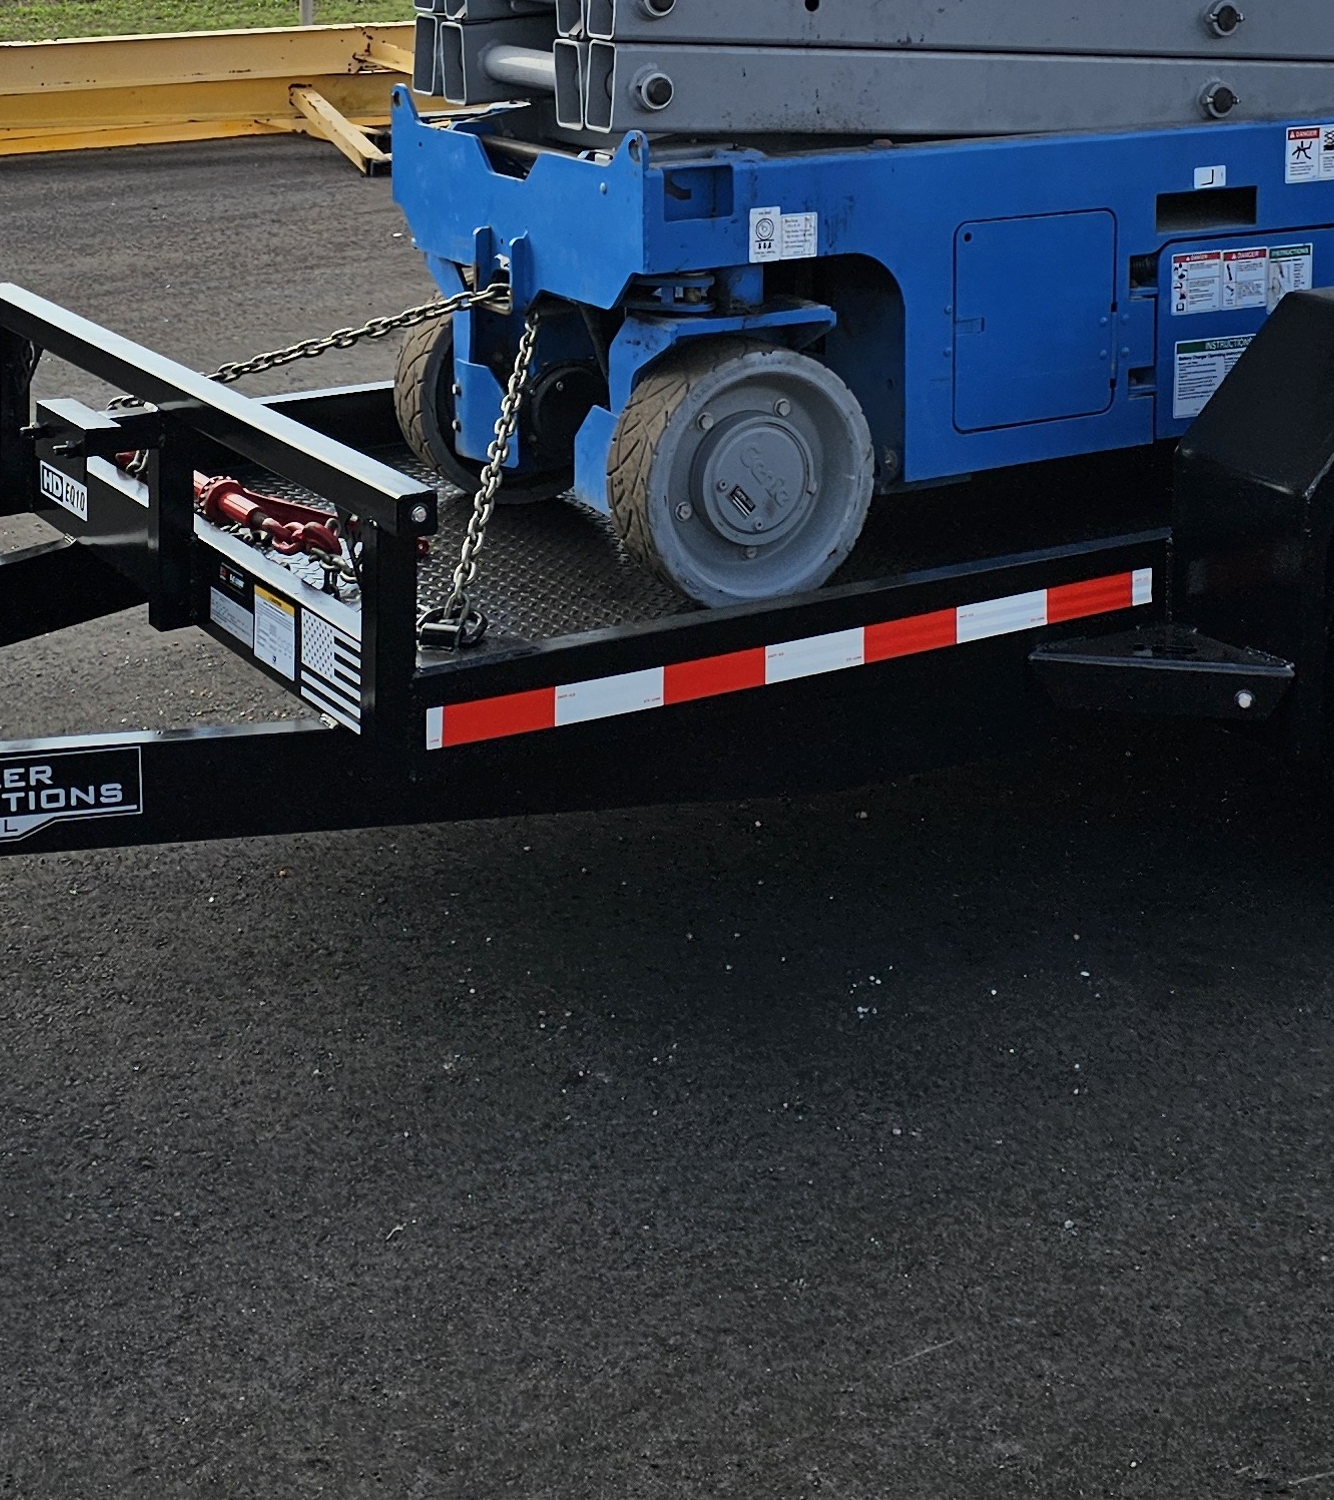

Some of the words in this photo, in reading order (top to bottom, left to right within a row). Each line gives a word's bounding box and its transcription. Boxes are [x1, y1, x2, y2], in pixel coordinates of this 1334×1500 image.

[1295, 130, 1318, 138] DANGER
[1237, 250, 1260, 259] DANGER
[43, 468, 63, 498] HD
[65, 482, 86, 512] EQ10
